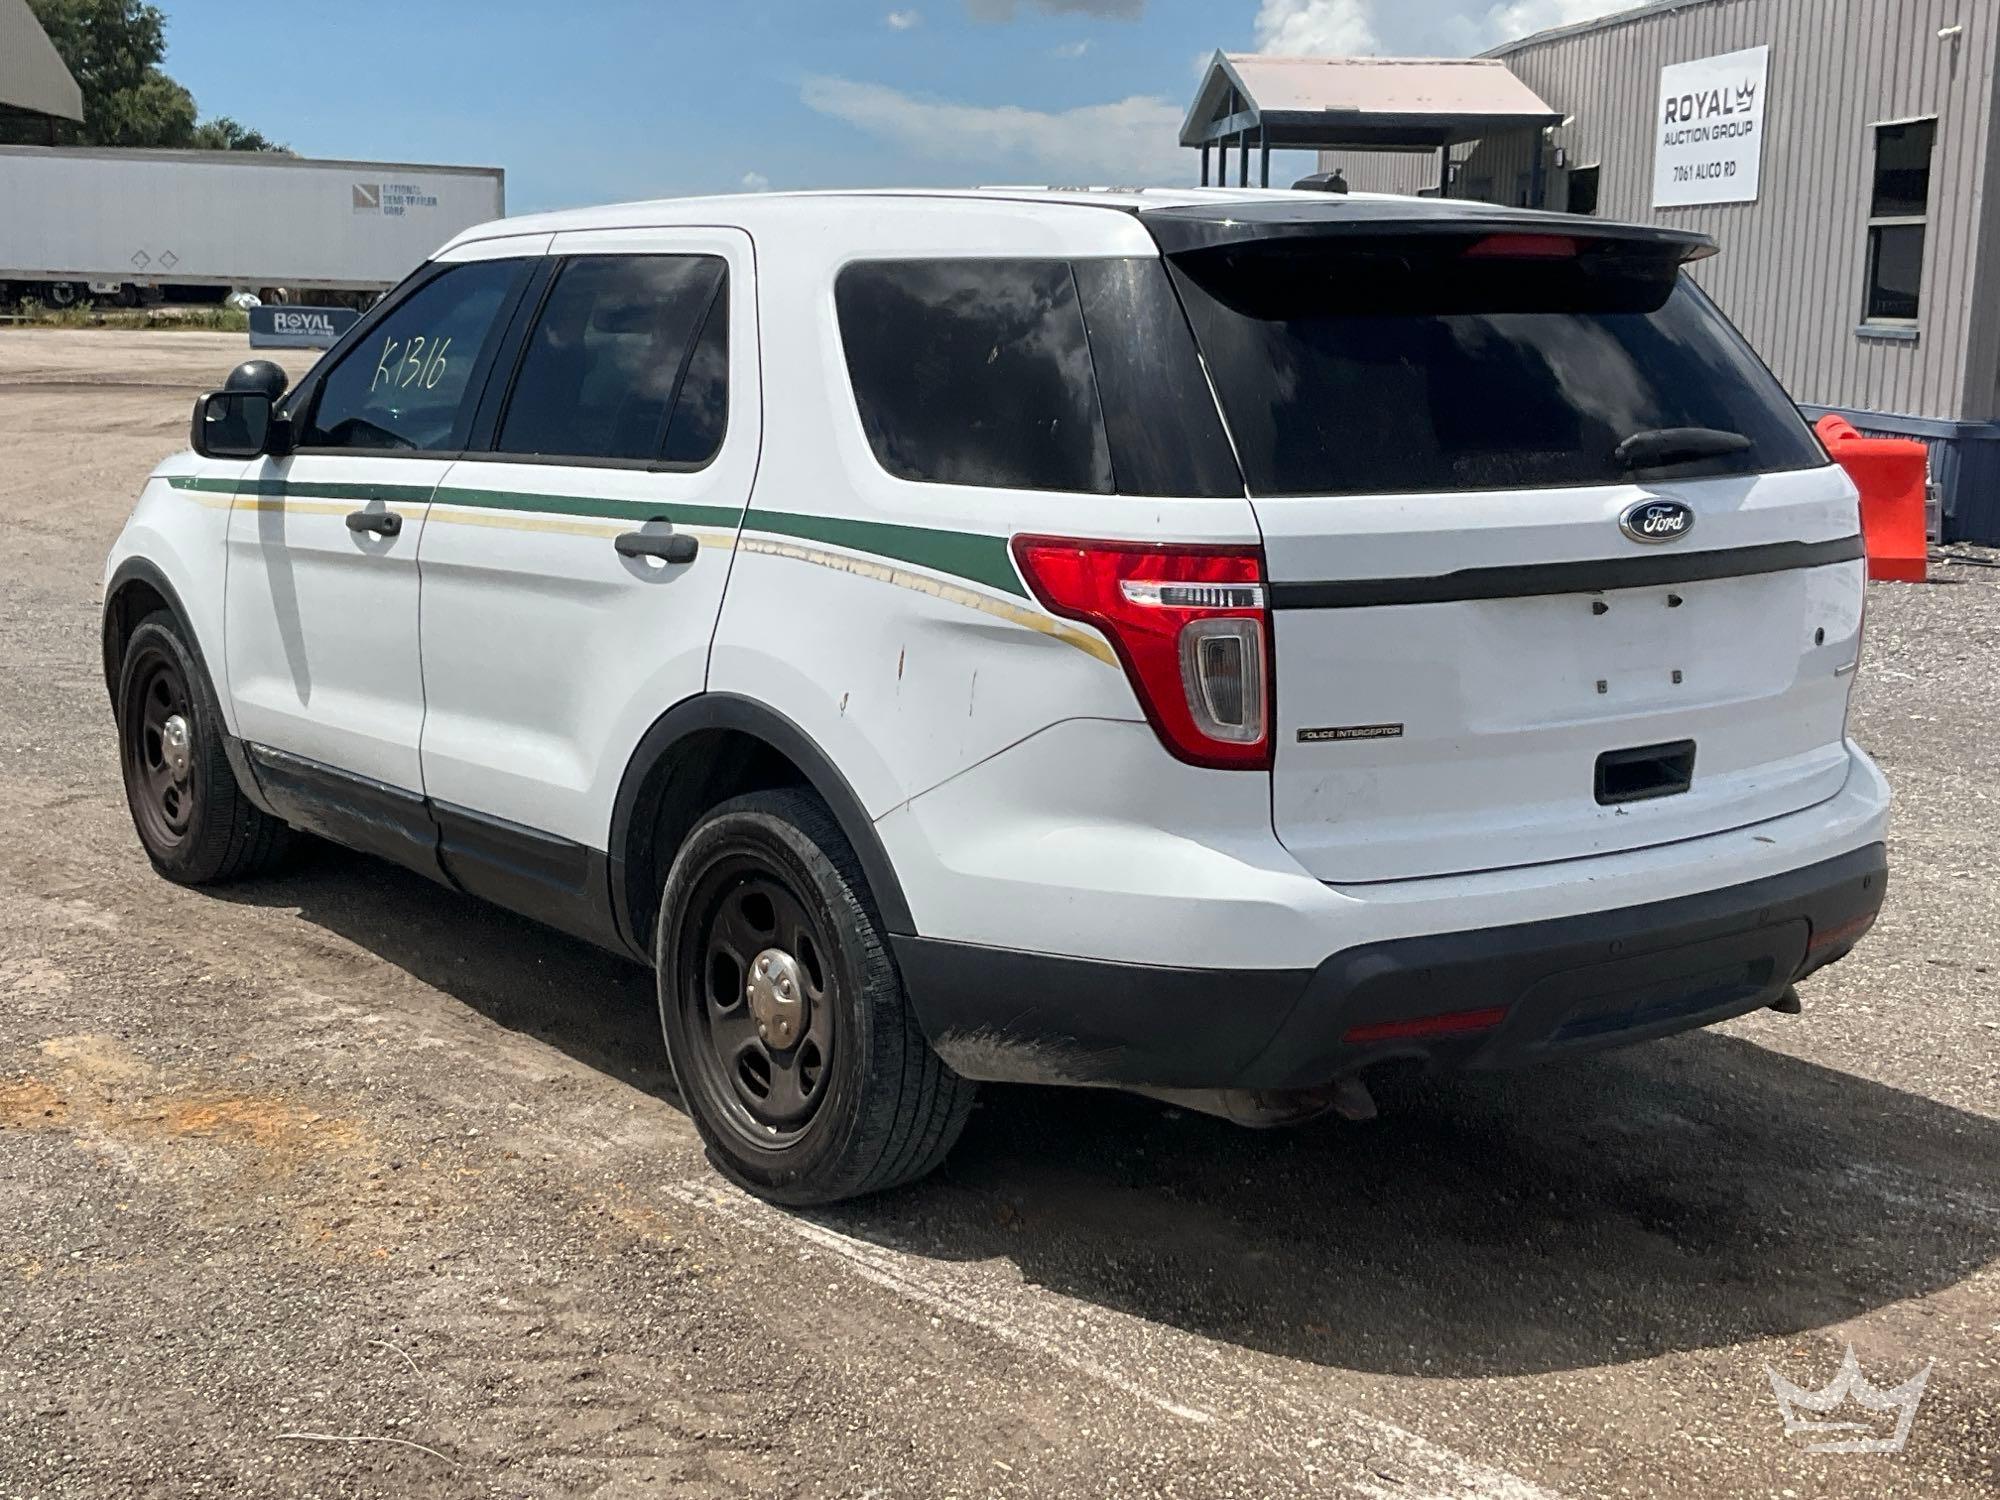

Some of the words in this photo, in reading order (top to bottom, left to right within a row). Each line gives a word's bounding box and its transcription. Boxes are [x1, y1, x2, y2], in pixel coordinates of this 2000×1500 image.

[1664, 87, 1734, 125] ROYAL
[1663, 127, 1710, 146] AUCTION
[1712, 120, 1753, 140] GROUP
[1673, 165, 1693, 182] 7061
[1695, 161, 1721, 180] ALICO
[1724, 160, 1737, 177] RD
[274, 312, 334, 330] ROYAL
[371, 336, 451, 392] K1316
[1643, 506, 1685, 533] Ford
[1300, 730, 1335, 740] POLICE
[1336, 726, 1400, 738] INTERCEPTOR
